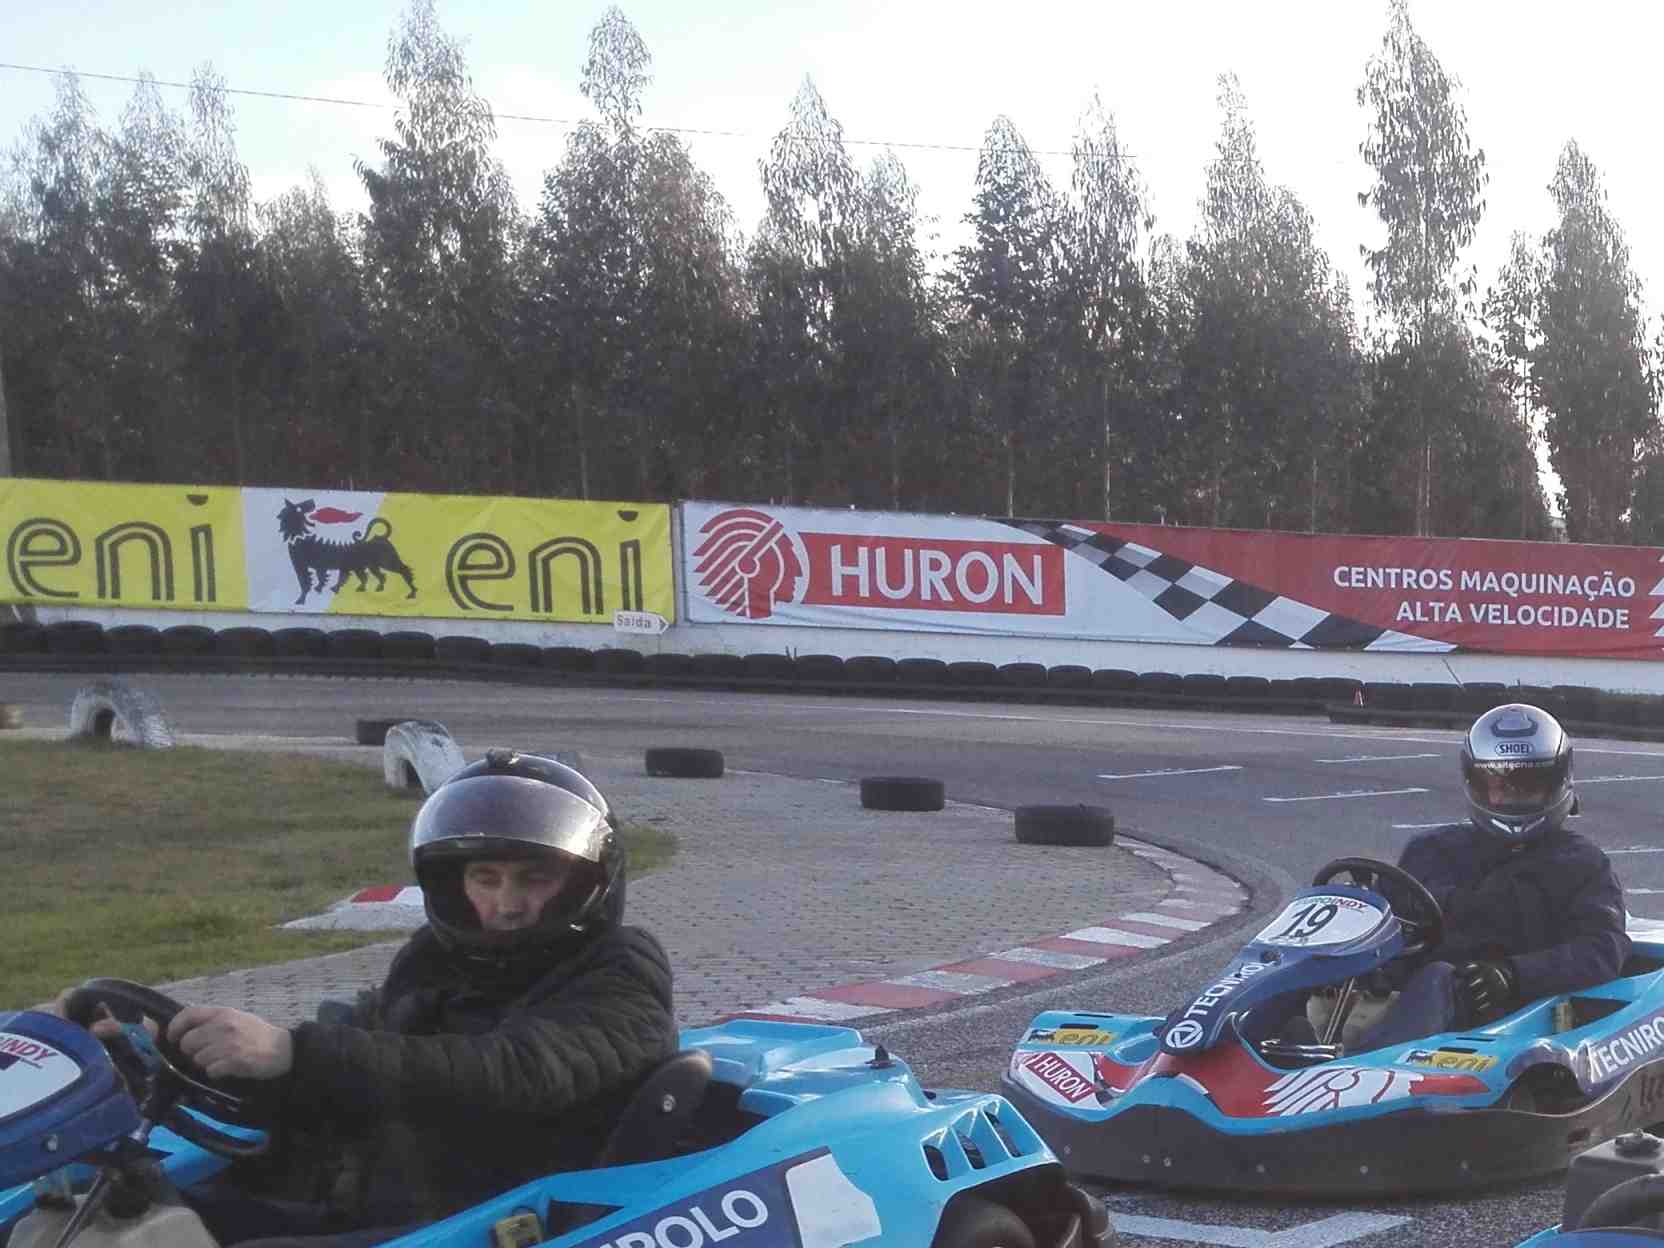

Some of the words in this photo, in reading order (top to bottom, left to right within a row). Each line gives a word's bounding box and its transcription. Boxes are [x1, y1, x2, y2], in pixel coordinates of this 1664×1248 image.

[8, 493, 217, 603] eni
[445, 509, 643, 615] eni
[830, 543, 1043, 606] HURON
[1334, 566, 1453, 591] CENTROS
[1460, 570, 1636, 600] MAQUINAÇÃO
[1396, 600, 1464, 623] ALTA
[1470, 603, 1630, 630] VELOCIDADE
[1499, 743, 1529, 754] SHOEI
[1279, 903, 1339, 938] 19
[1034, 1055, 1091, 1099] HURON
